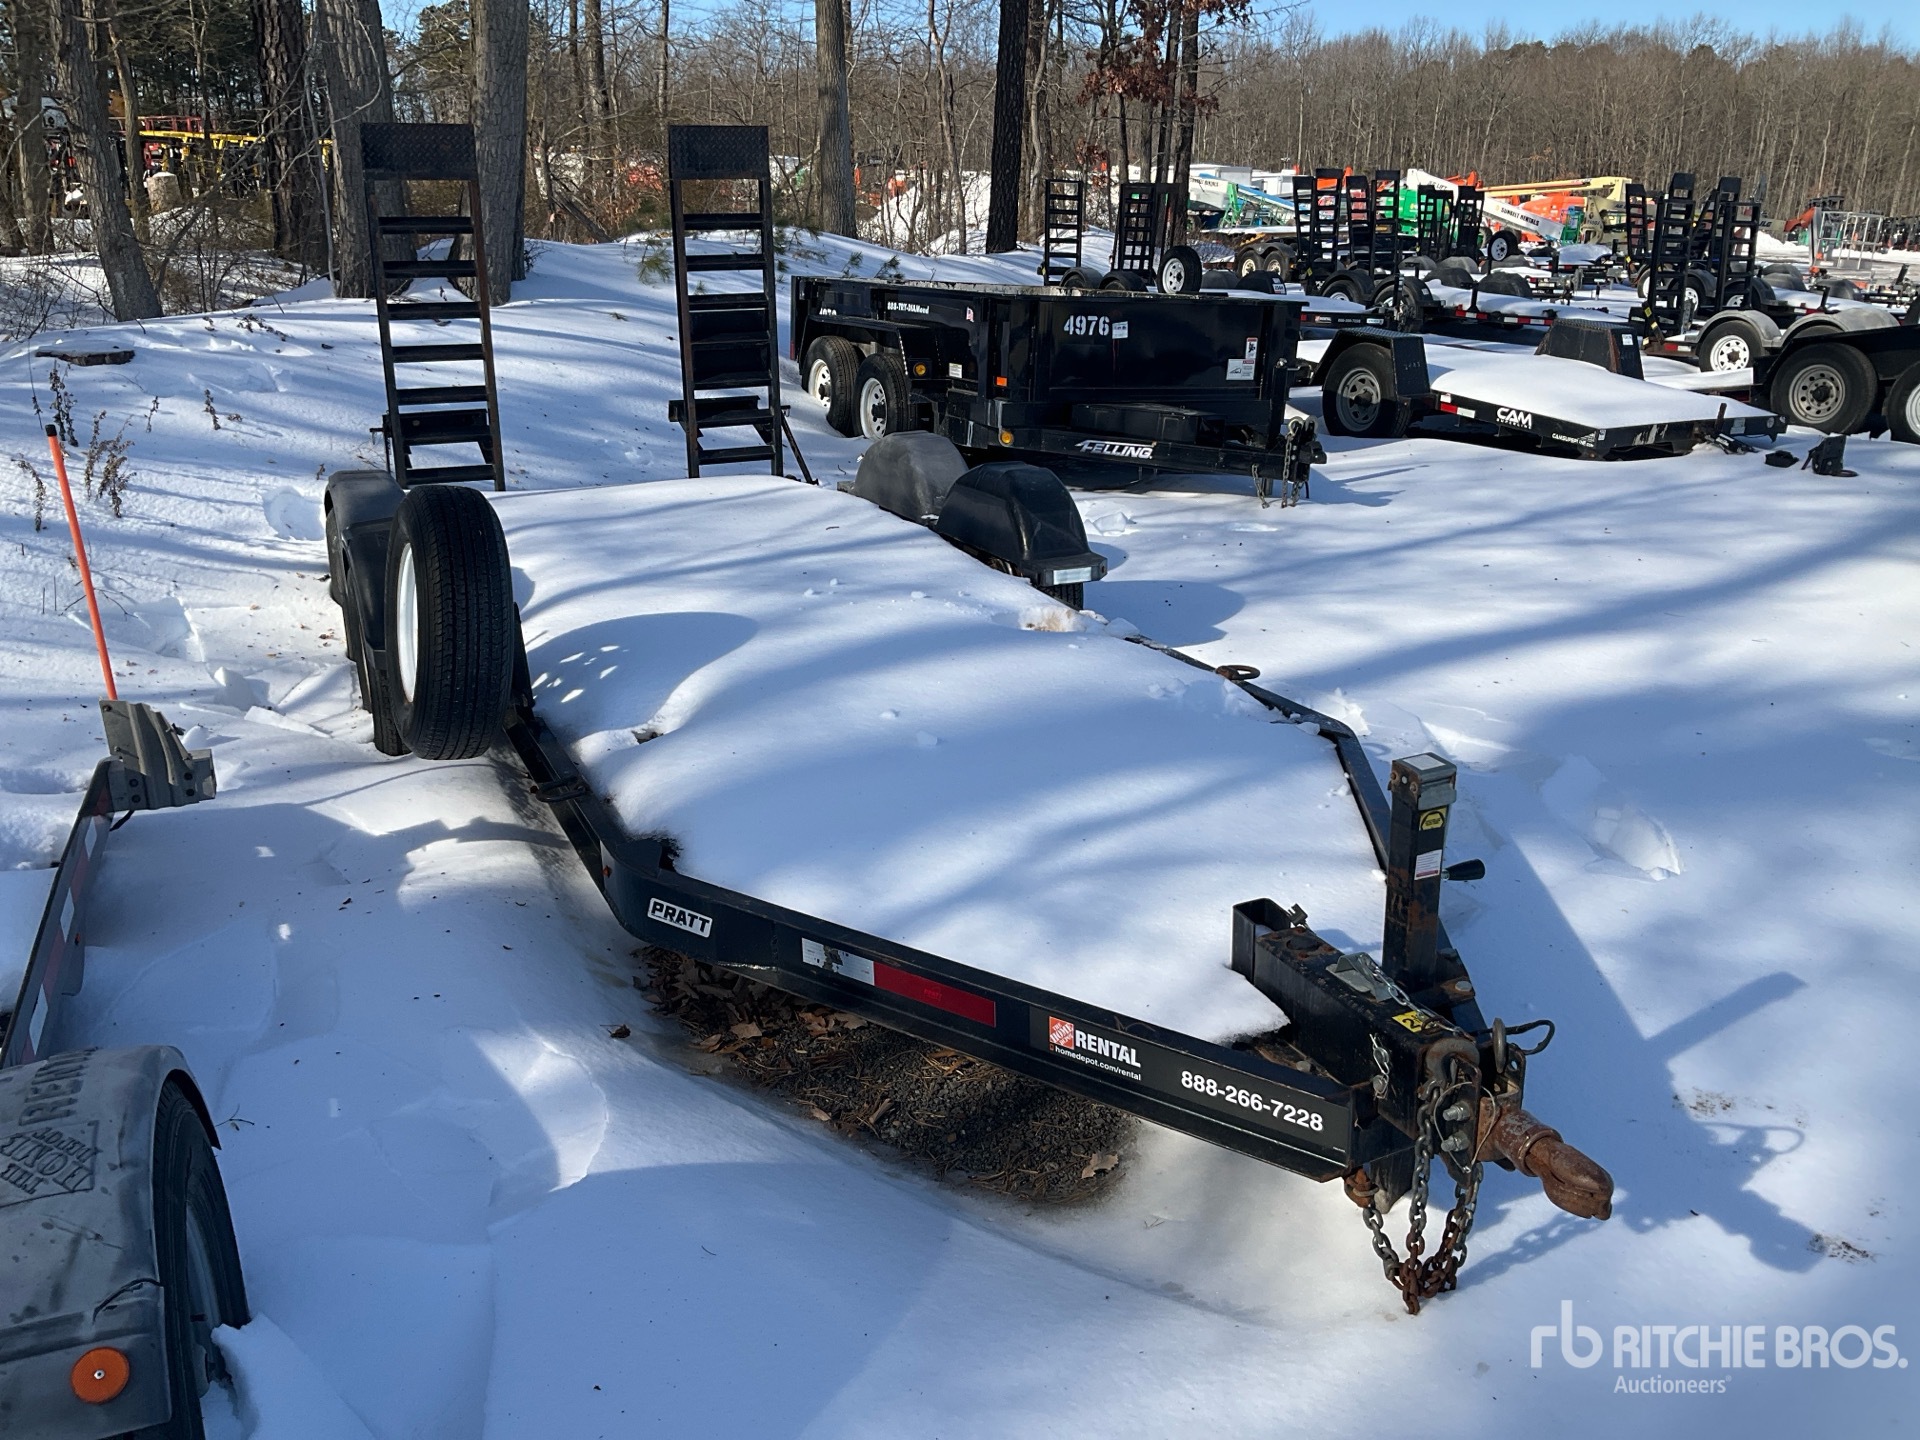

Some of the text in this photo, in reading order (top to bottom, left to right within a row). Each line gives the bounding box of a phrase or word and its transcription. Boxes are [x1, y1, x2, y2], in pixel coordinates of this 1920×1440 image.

[1063, 315, 1110, 336] 4976
[1496, 407, 1532, 427] CAM
[1076, 440, 1154, 459] FELLING
[651, 901, 710, 933] PRATT
[1050, 1023, 1072, 1043] HOME
[1075, 1029, 1141, 1068] RENTAL
[1055, 1045, 1141, 1081] homedepot.com/rental
[1181, 1070, 1324, 1132] 888-266-7228
